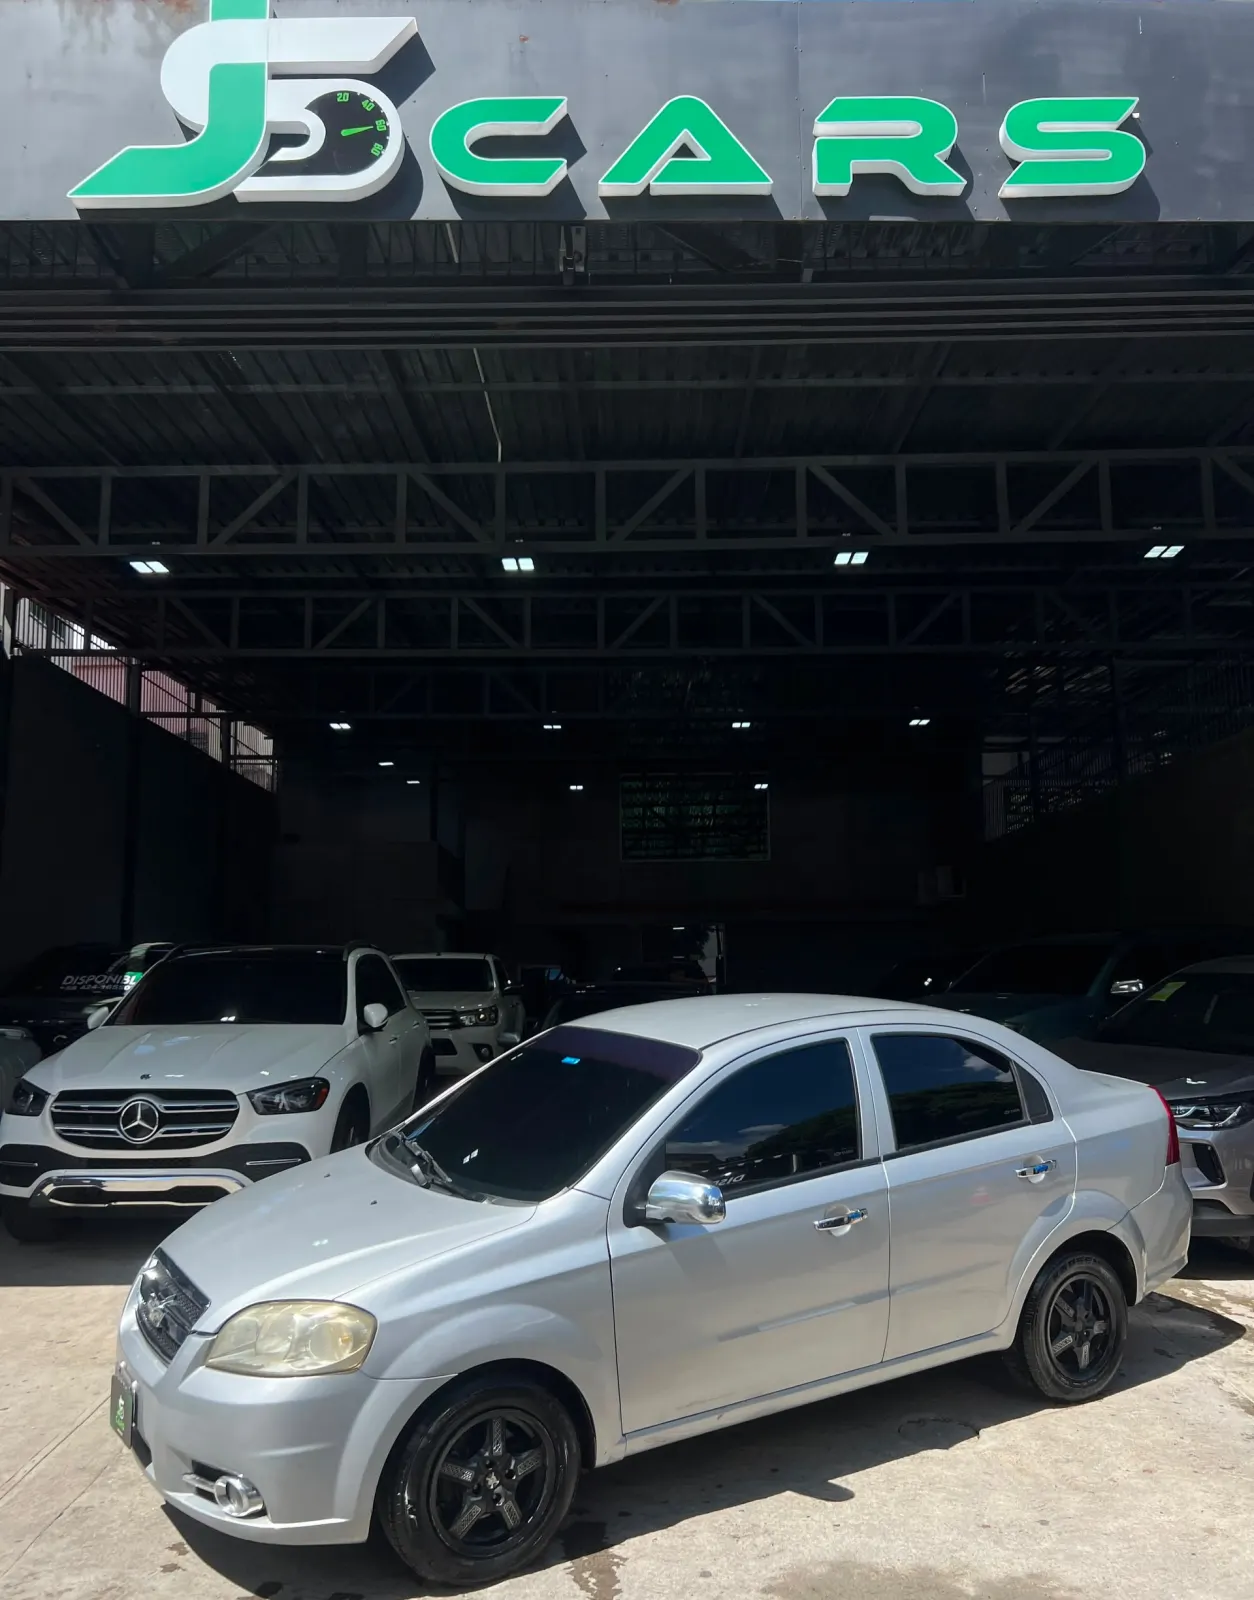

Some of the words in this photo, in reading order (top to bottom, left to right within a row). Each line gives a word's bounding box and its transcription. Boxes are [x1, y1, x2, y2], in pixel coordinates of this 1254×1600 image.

[336, 92, 350, 102] 20
[361, 99, 375, 112] 40
[375, 119, 387, 131] 60
[370, 142, 384, 157] 80
[430, 96, 1147, 201] CARS
[62, 974, 138, 985] DISPONIBL
